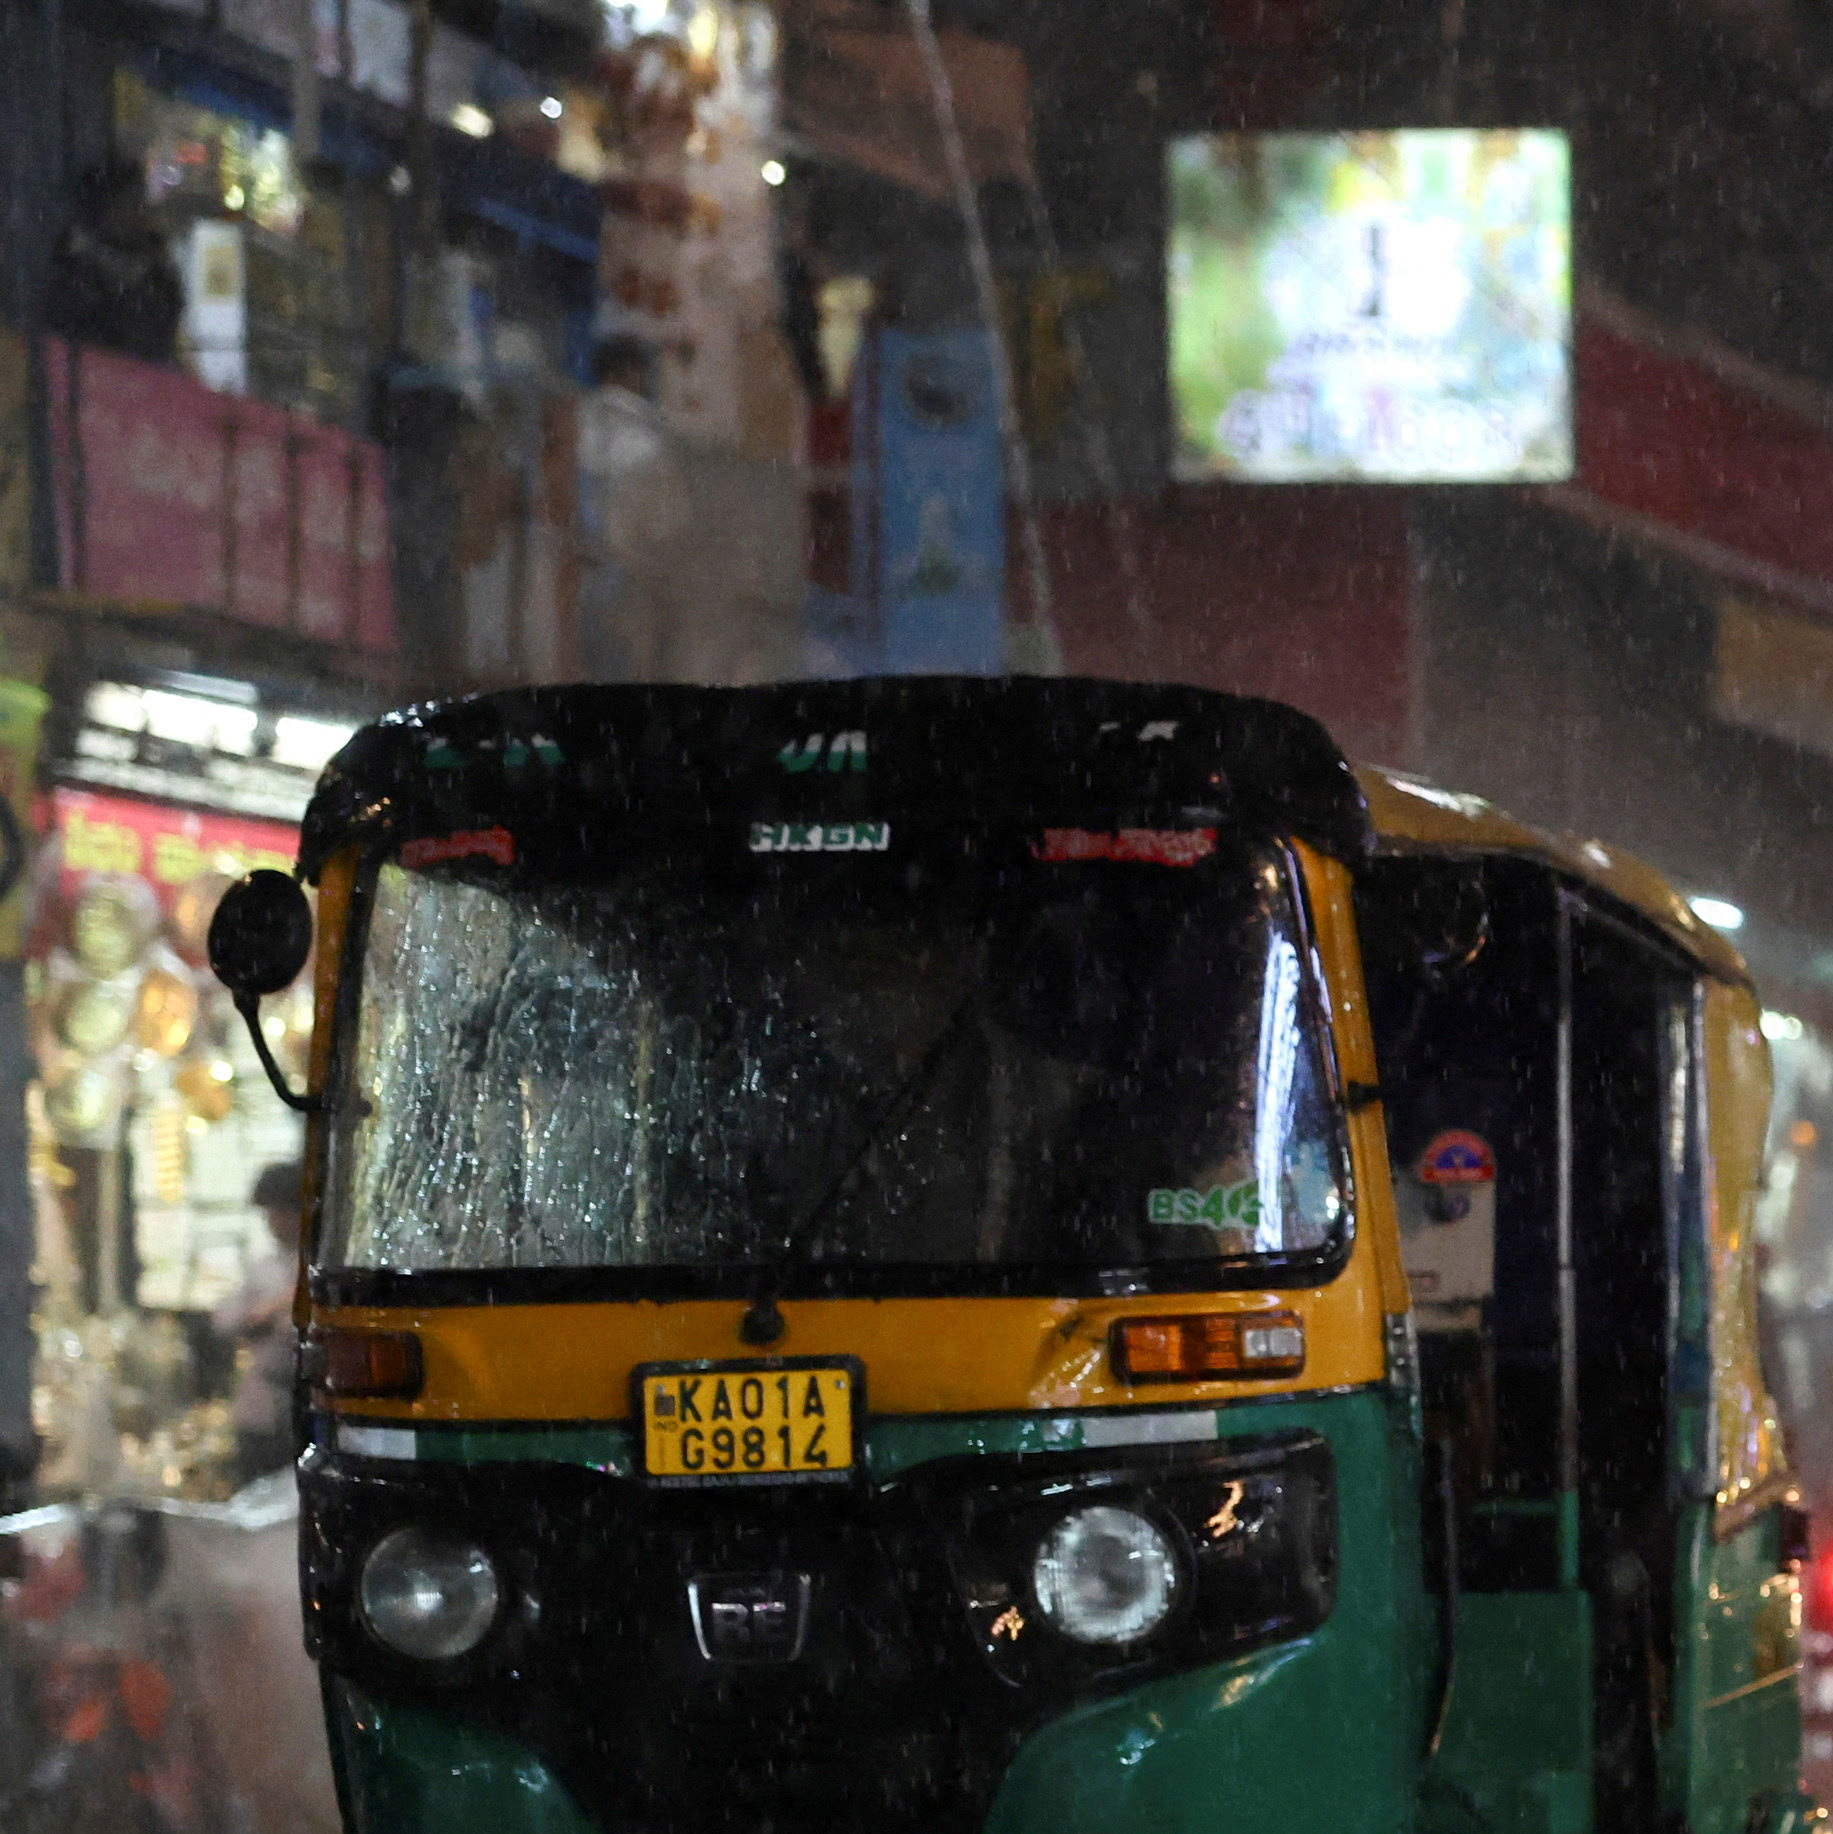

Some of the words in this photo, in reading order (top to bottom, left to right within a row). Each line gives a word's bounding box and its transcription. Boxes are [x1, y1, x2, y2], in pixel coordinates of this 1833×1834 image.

[678, 1375, 825, 1423] KA01A
[680, 1424, 828, 1470] G9814
[711, 1601, 787, 1644] RE
